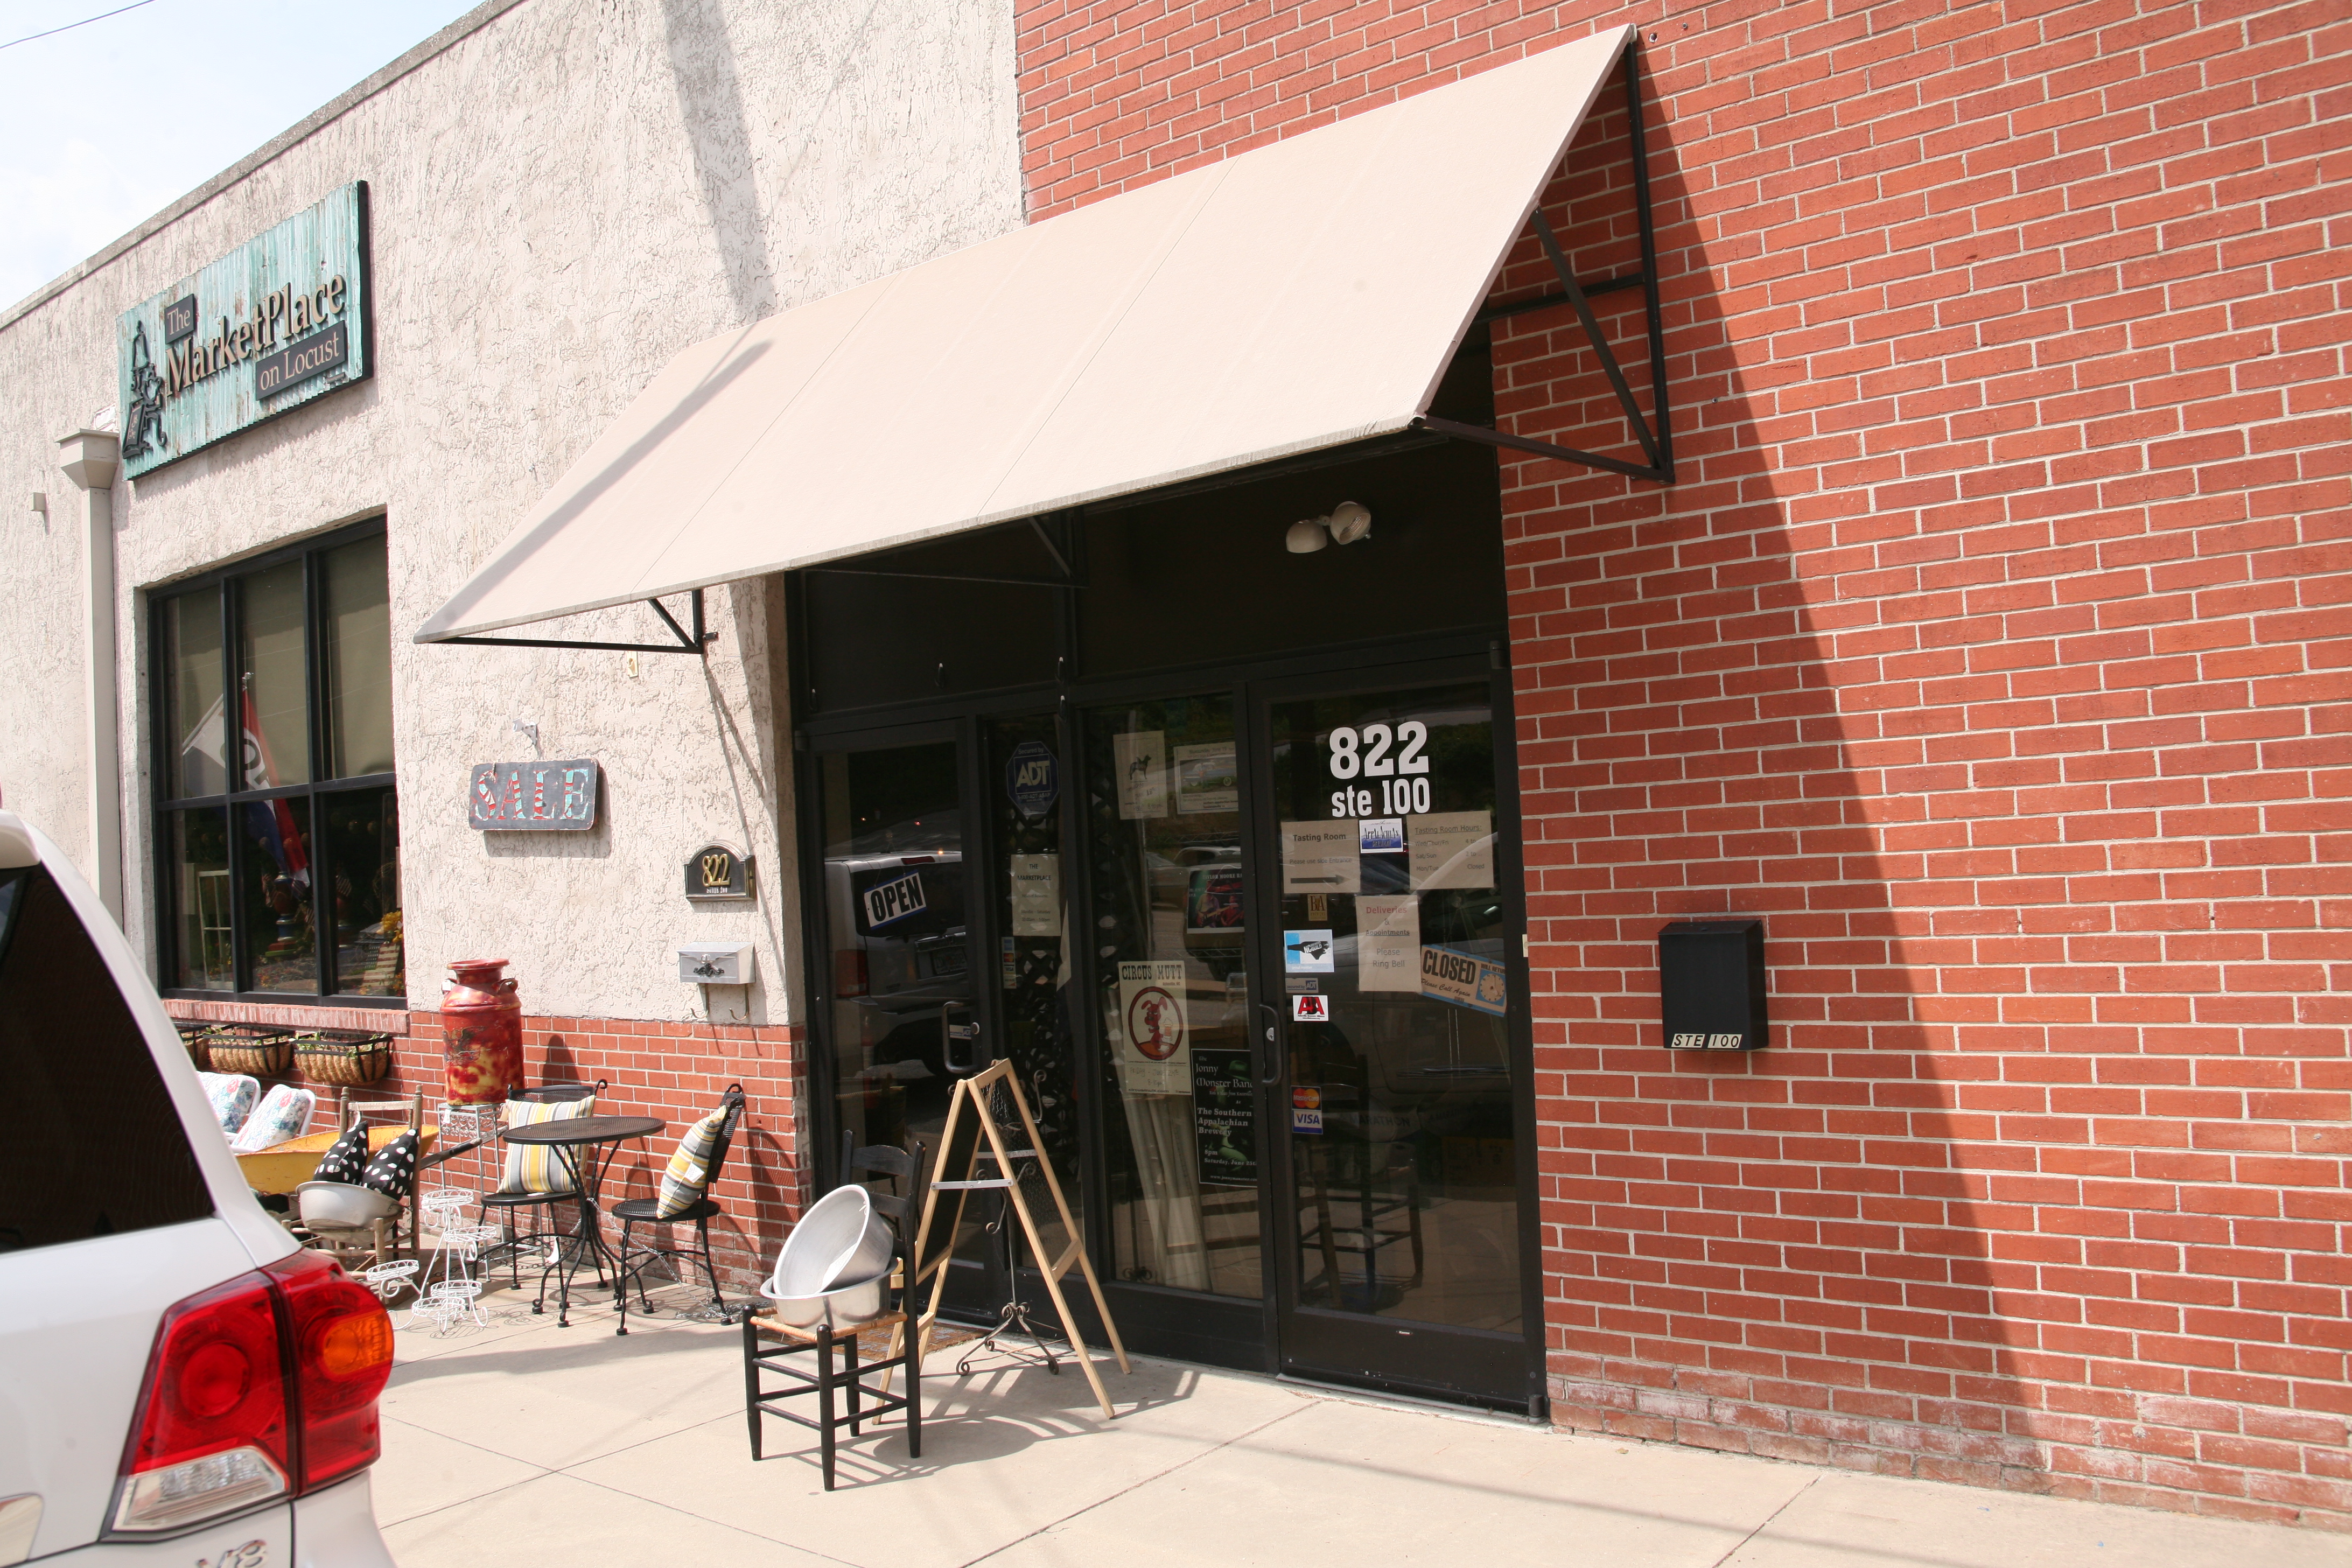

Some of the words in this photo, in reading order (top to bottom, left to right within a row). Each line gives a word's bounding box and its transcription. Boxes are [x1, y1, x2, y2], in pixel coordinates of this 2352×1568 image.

[167, 310, 190, 335] The
[166, 274, 346, 397] MarketPlace
[260, 367, 280, 390] on
[284, 332, 340, 380] Locust
[1329, 721, 1429, 779] 822
[1016, 760, 1049, 787] ADT
[475, 767, 589, 821] SALE
[1332, 785, 1372, 817] ste
[1382, 777, 1430, 815] 100
[1293, 834, 1321, 842] Tasting
[702, 854, 731, 887] 822
[870, 876, 924, 922] OPEN
[1311, 896, 1325, 911] BA
[1366, 906, 1407, 914] Deliveries
[1373, 960, 1389, 969] Ring
[1423, 950, 1476, 985] CLOSED
[1122, 965, 1152, 980] CIRCUS
[1157, 965, 1182, 979] MUTT
[1421, 978, 1437, 988] Please
[1439, 984, 1452, 992] Call
[1454, 988, 1471, 997] Again
[1674, 1034, 1703, 1046] STE
[1713, 1035, 1739, 1047] 100
[1195, 1063, 1219, 1076] Jonny
[1196, 1078, 1231, 1087] Monster
[1214, 1108, 1252, 1116] Southern
[1296, 1114, 1320, 1124] VISA
[1198, 1117, 1249, 1126] Appalachian
[1198, 1127, 1232, 1137] Brewery
